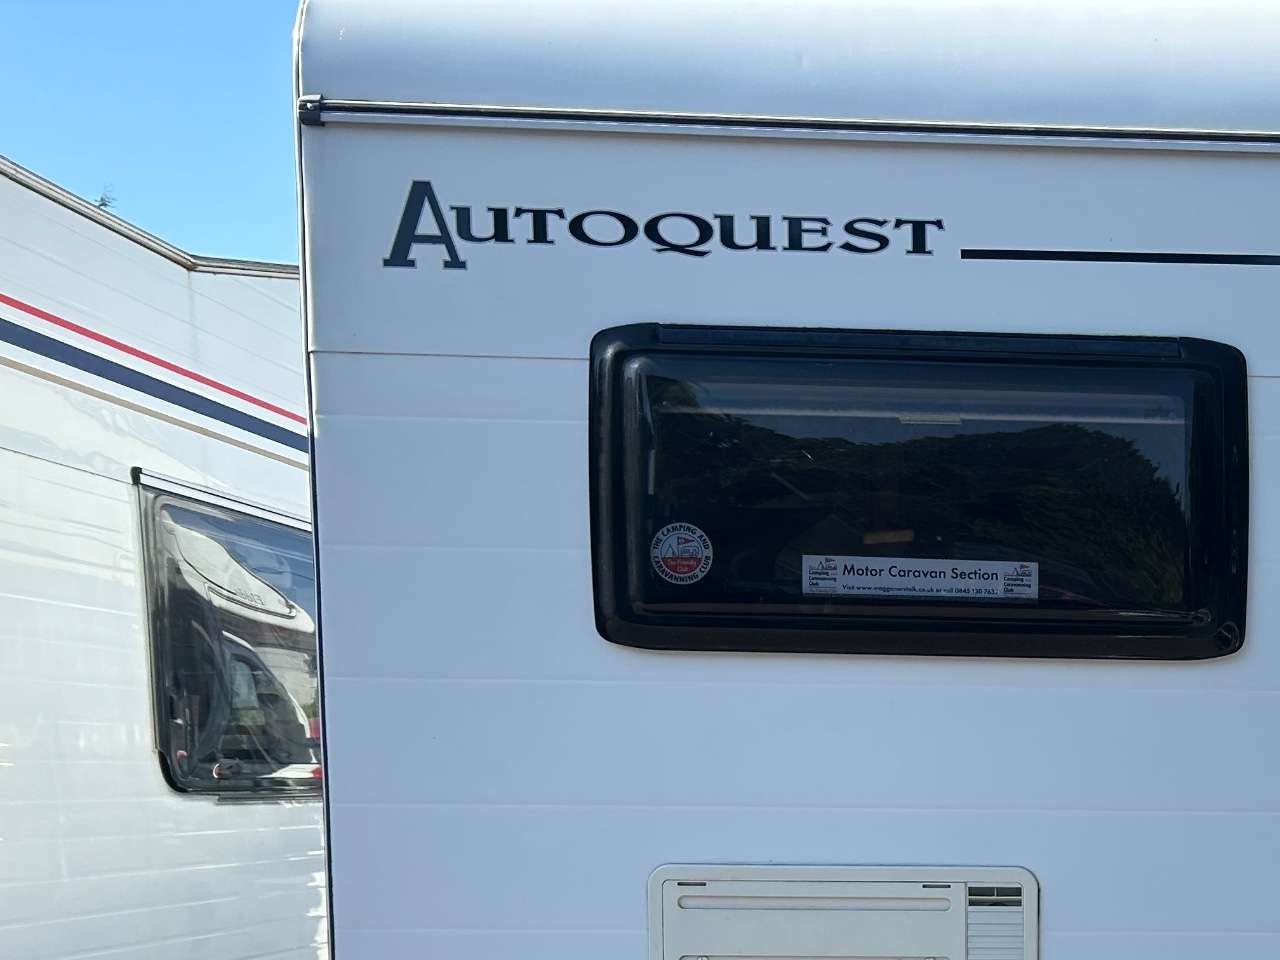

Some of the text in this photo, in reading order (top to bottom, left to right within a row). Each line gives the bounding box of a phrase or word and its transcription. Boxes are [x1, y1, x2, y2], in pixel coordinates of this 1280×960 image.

[382, 180, 945, 269] AUTOQUEST
[661, 524, 697, 537] CAMPING
[697, 534, 710, 550] AND
[652, 555, 699, 583] CARAVANNING
[699, 555, 711, 574] CLUB
[843, 563, 999, 581] Motor Caravan Section
